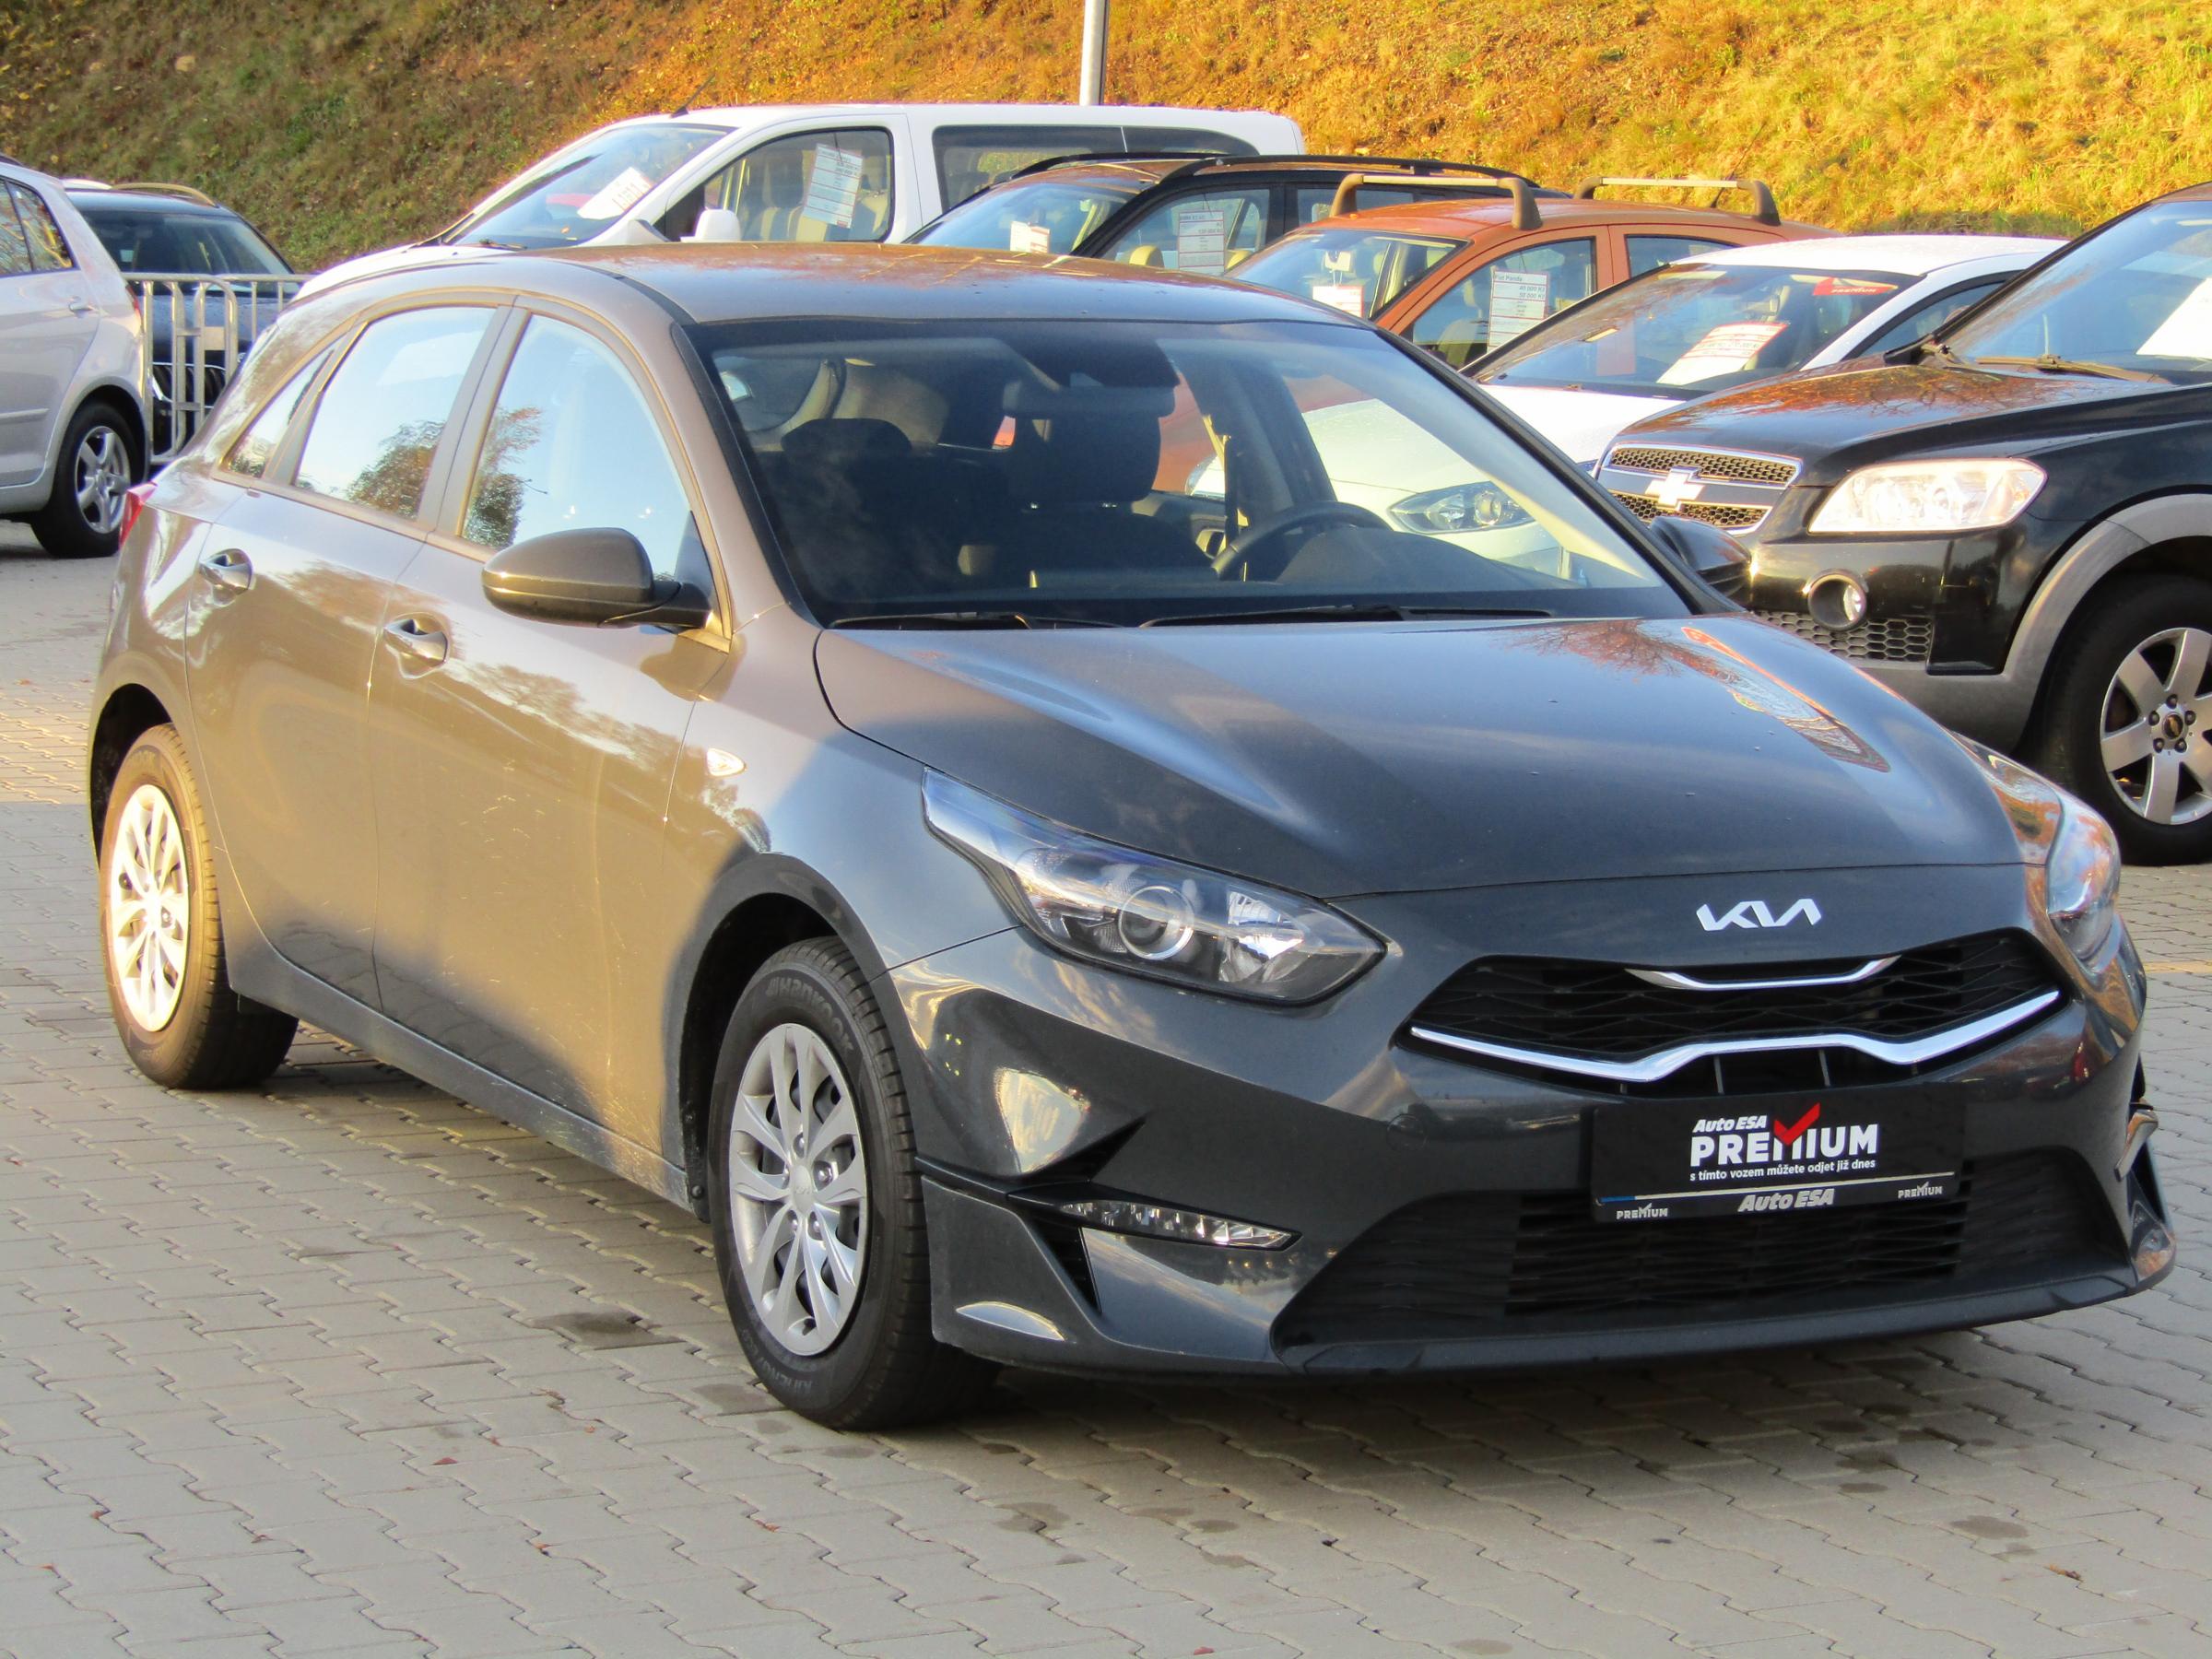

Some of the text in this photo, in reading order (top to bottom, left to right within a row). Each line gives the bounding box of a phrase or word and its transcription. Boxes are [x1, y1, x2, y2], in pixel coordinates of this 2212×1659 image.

[1696, 898, 1822, 931] KIA
[1692, 1115, 1767, 1133] Auto ESA
[1690, 1110, 1878, 1167] PREMIUM
[1689, 1159, 1876, 1181] s tímto vozem můžete odjet již dnes
[1737, 1188, 1835, 1212] Auto ESA
[1898, 1182, 1943, 1199] PREMIUM
[1616, 1203, 1668, 1219] PREMIUM
